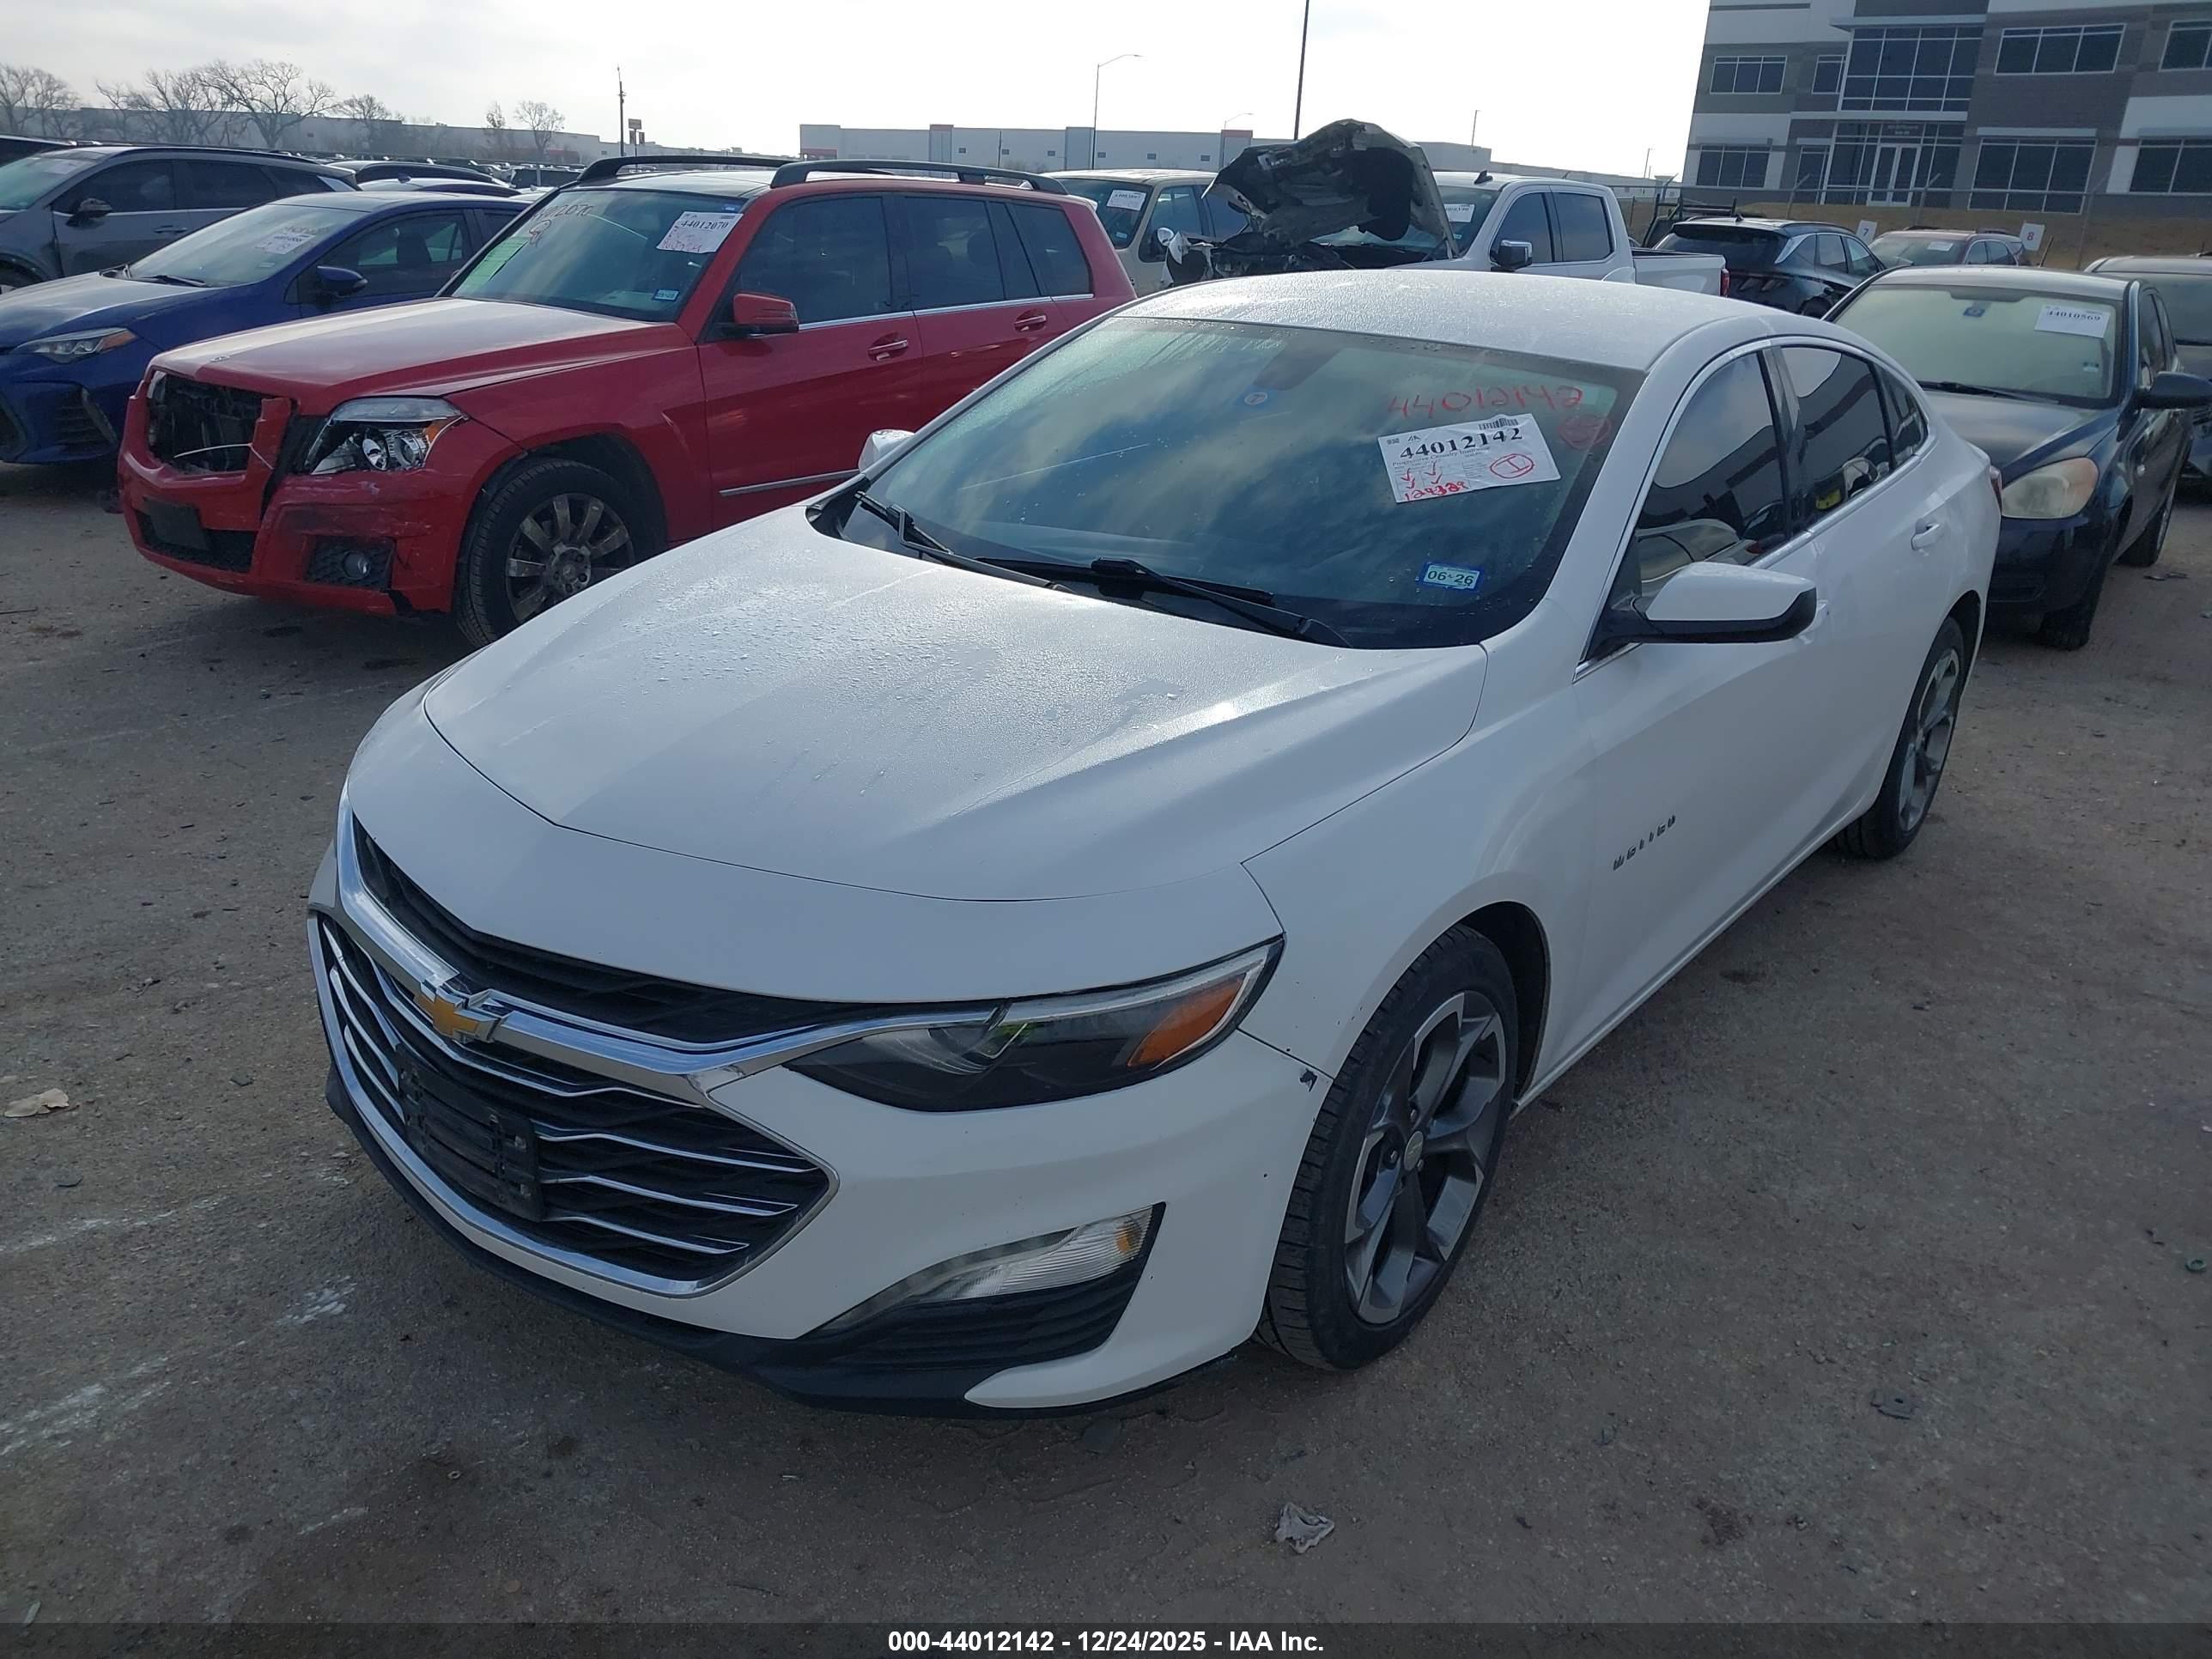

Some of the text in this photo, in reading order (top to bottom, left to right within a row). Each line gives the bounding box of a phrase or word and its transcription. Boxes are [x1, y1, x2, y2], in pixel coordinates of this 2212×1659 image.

[680, 219, 729, 230] 44012070
[1863, 228, 1869, 236] 7
[2027, 232, 2034, 241] 8
[1388, 386, 1583, 419] 44012142
[1400, 427, 1523, 459] 44012142
[1427, 570, 1474, 586] 06 26
